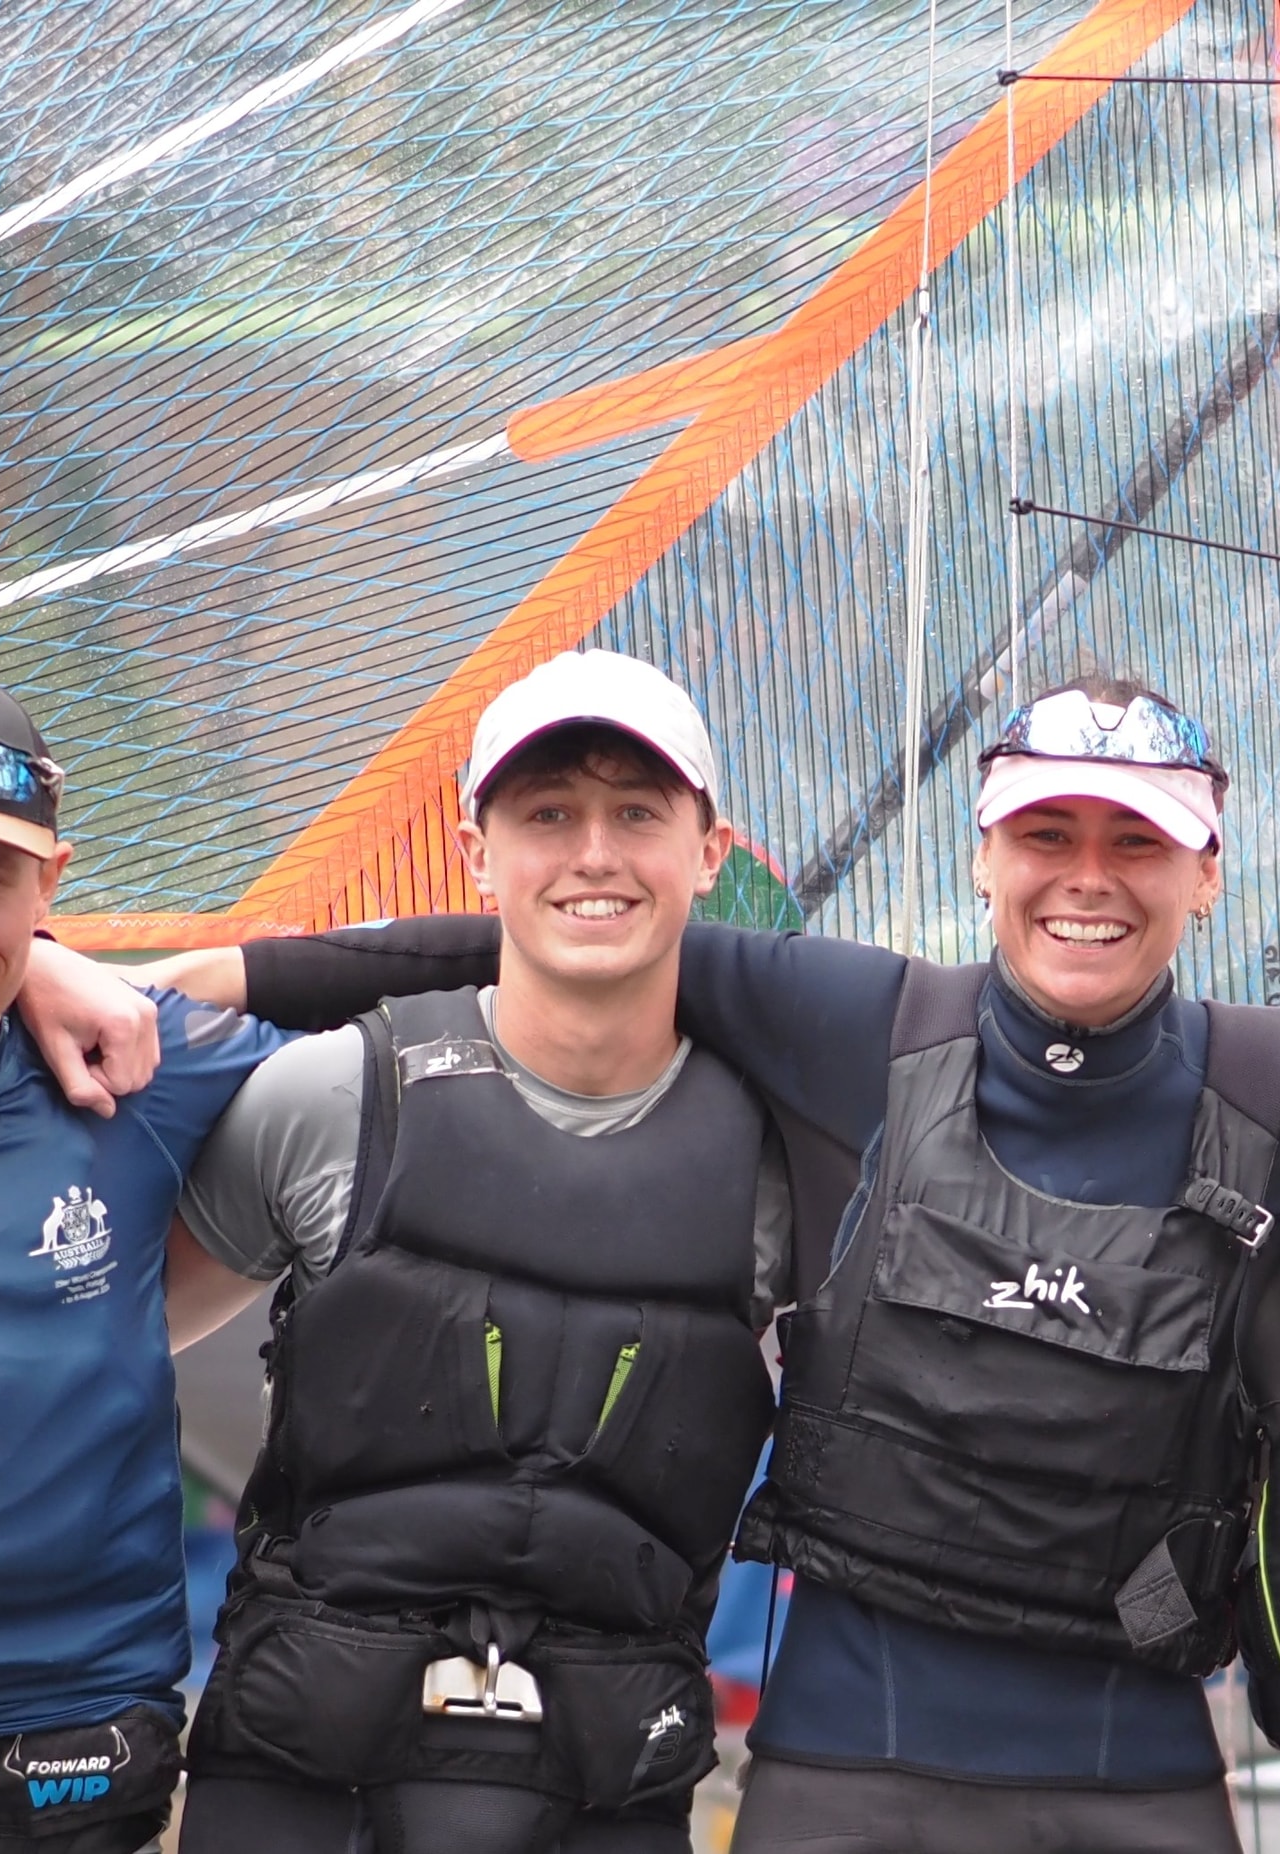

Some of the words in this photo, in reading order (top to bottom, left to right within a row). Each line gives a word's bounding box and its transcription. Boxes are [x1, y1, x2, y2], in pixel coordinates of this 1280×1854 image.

[982, 1264, 1090, 1314] zhik
[648, 1704, 685, 1740] zhik
[26, 1756, 111, 1775] FORWARD
[28, 1775, 110, 1808] WIP
